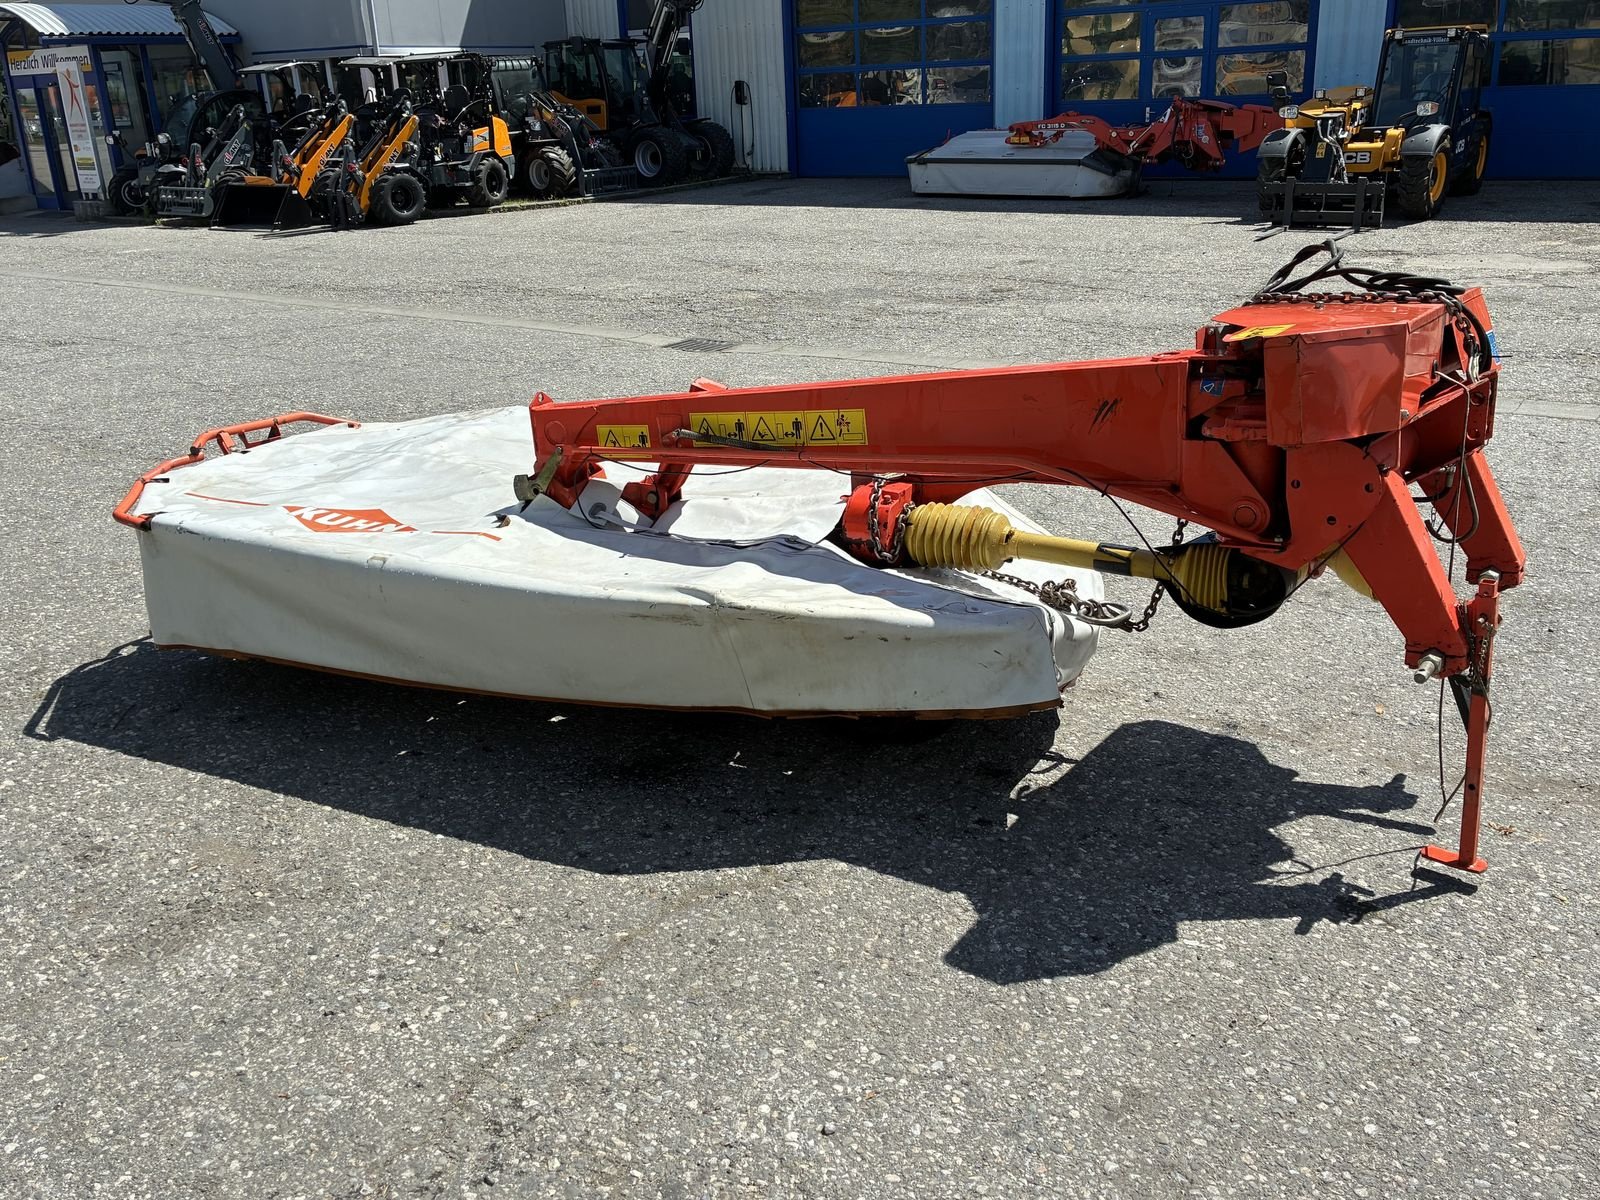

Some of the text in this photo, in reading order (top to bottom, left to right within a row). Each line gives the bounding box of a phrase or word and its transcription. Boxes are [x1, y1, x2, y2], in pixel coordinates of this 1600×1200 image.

[10, 54, 39, 71] Herzlich
[224, 139, 240, 165] GIANT
[319, 142, 336, 167] GIANT
[1343, 152, 1370, 164] CB
[288, 506, 408, 533] KUHN
